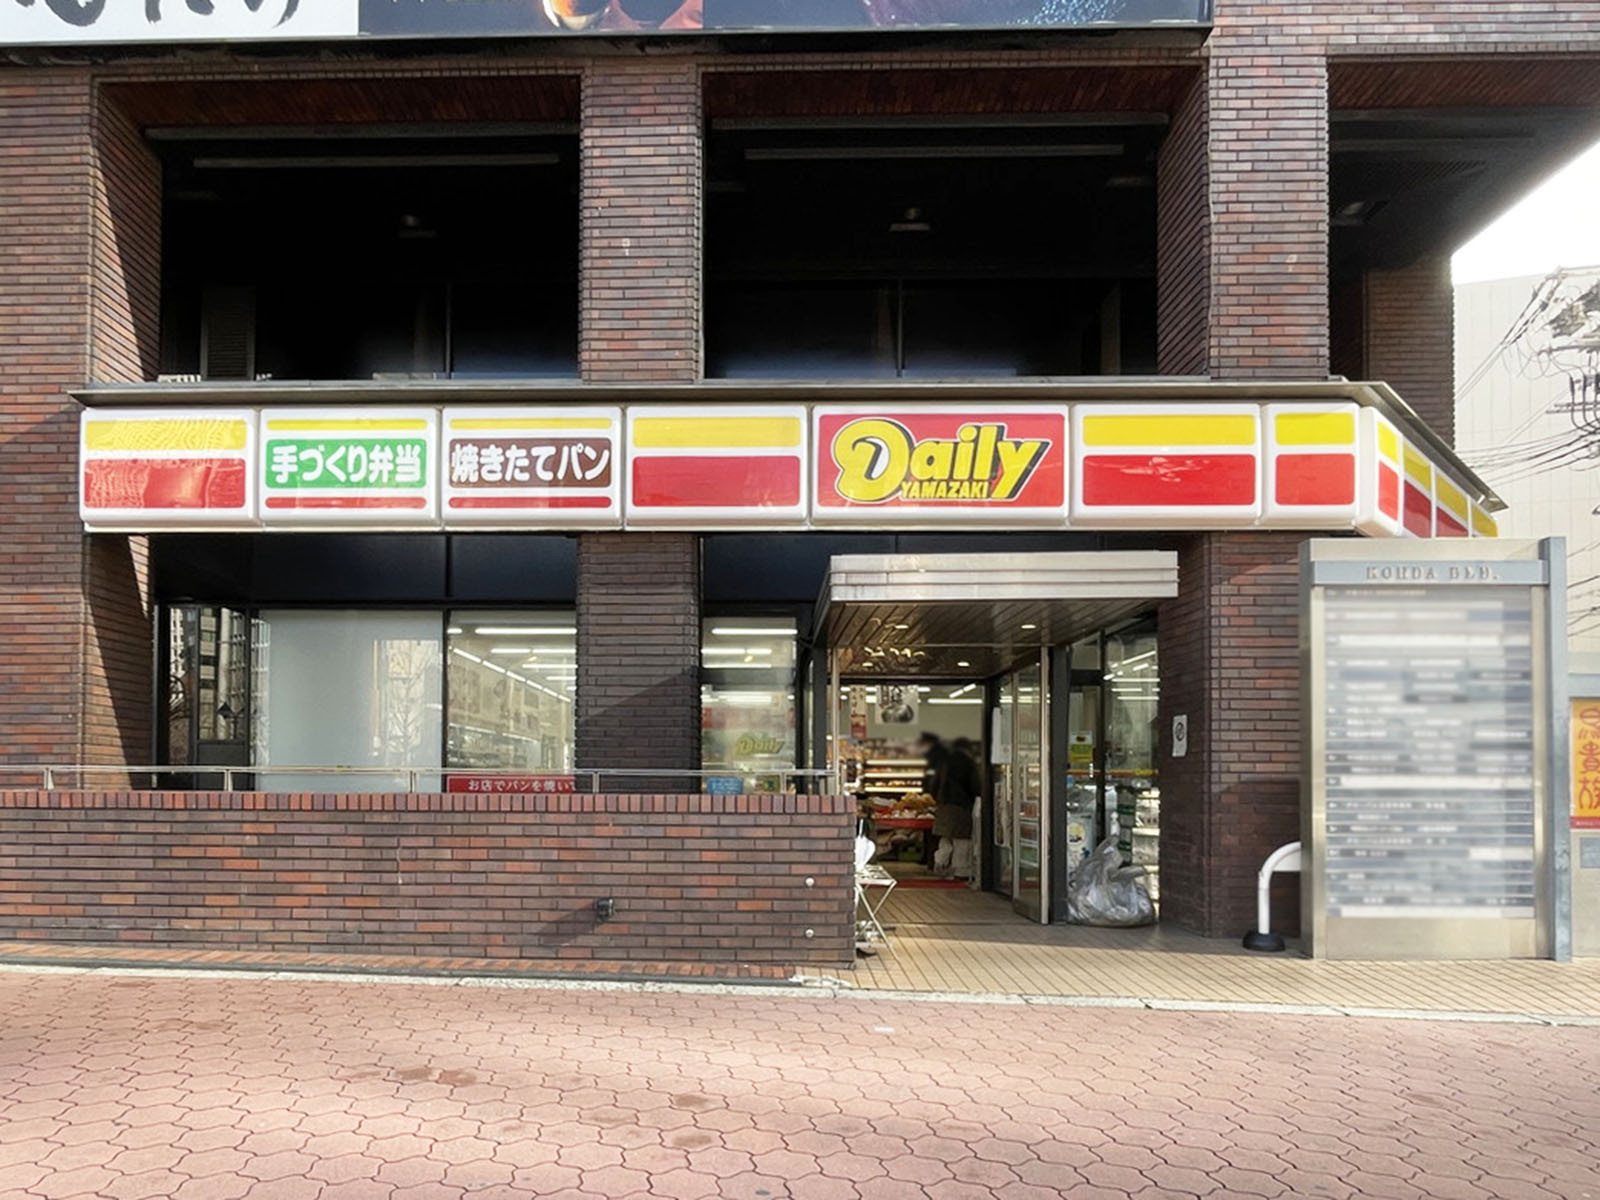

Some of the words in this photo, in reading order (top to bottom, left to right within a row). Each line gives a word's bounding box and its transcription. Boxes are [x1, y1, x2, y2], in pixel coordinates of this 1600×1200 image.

[271, 444, 421, 484] 手づくり弁当
[451, 442, 610, 483] 焼きたてパン
[832, 417, 1051, 502] Daily
[901, 480, 989, 499] YAMAZAKI
